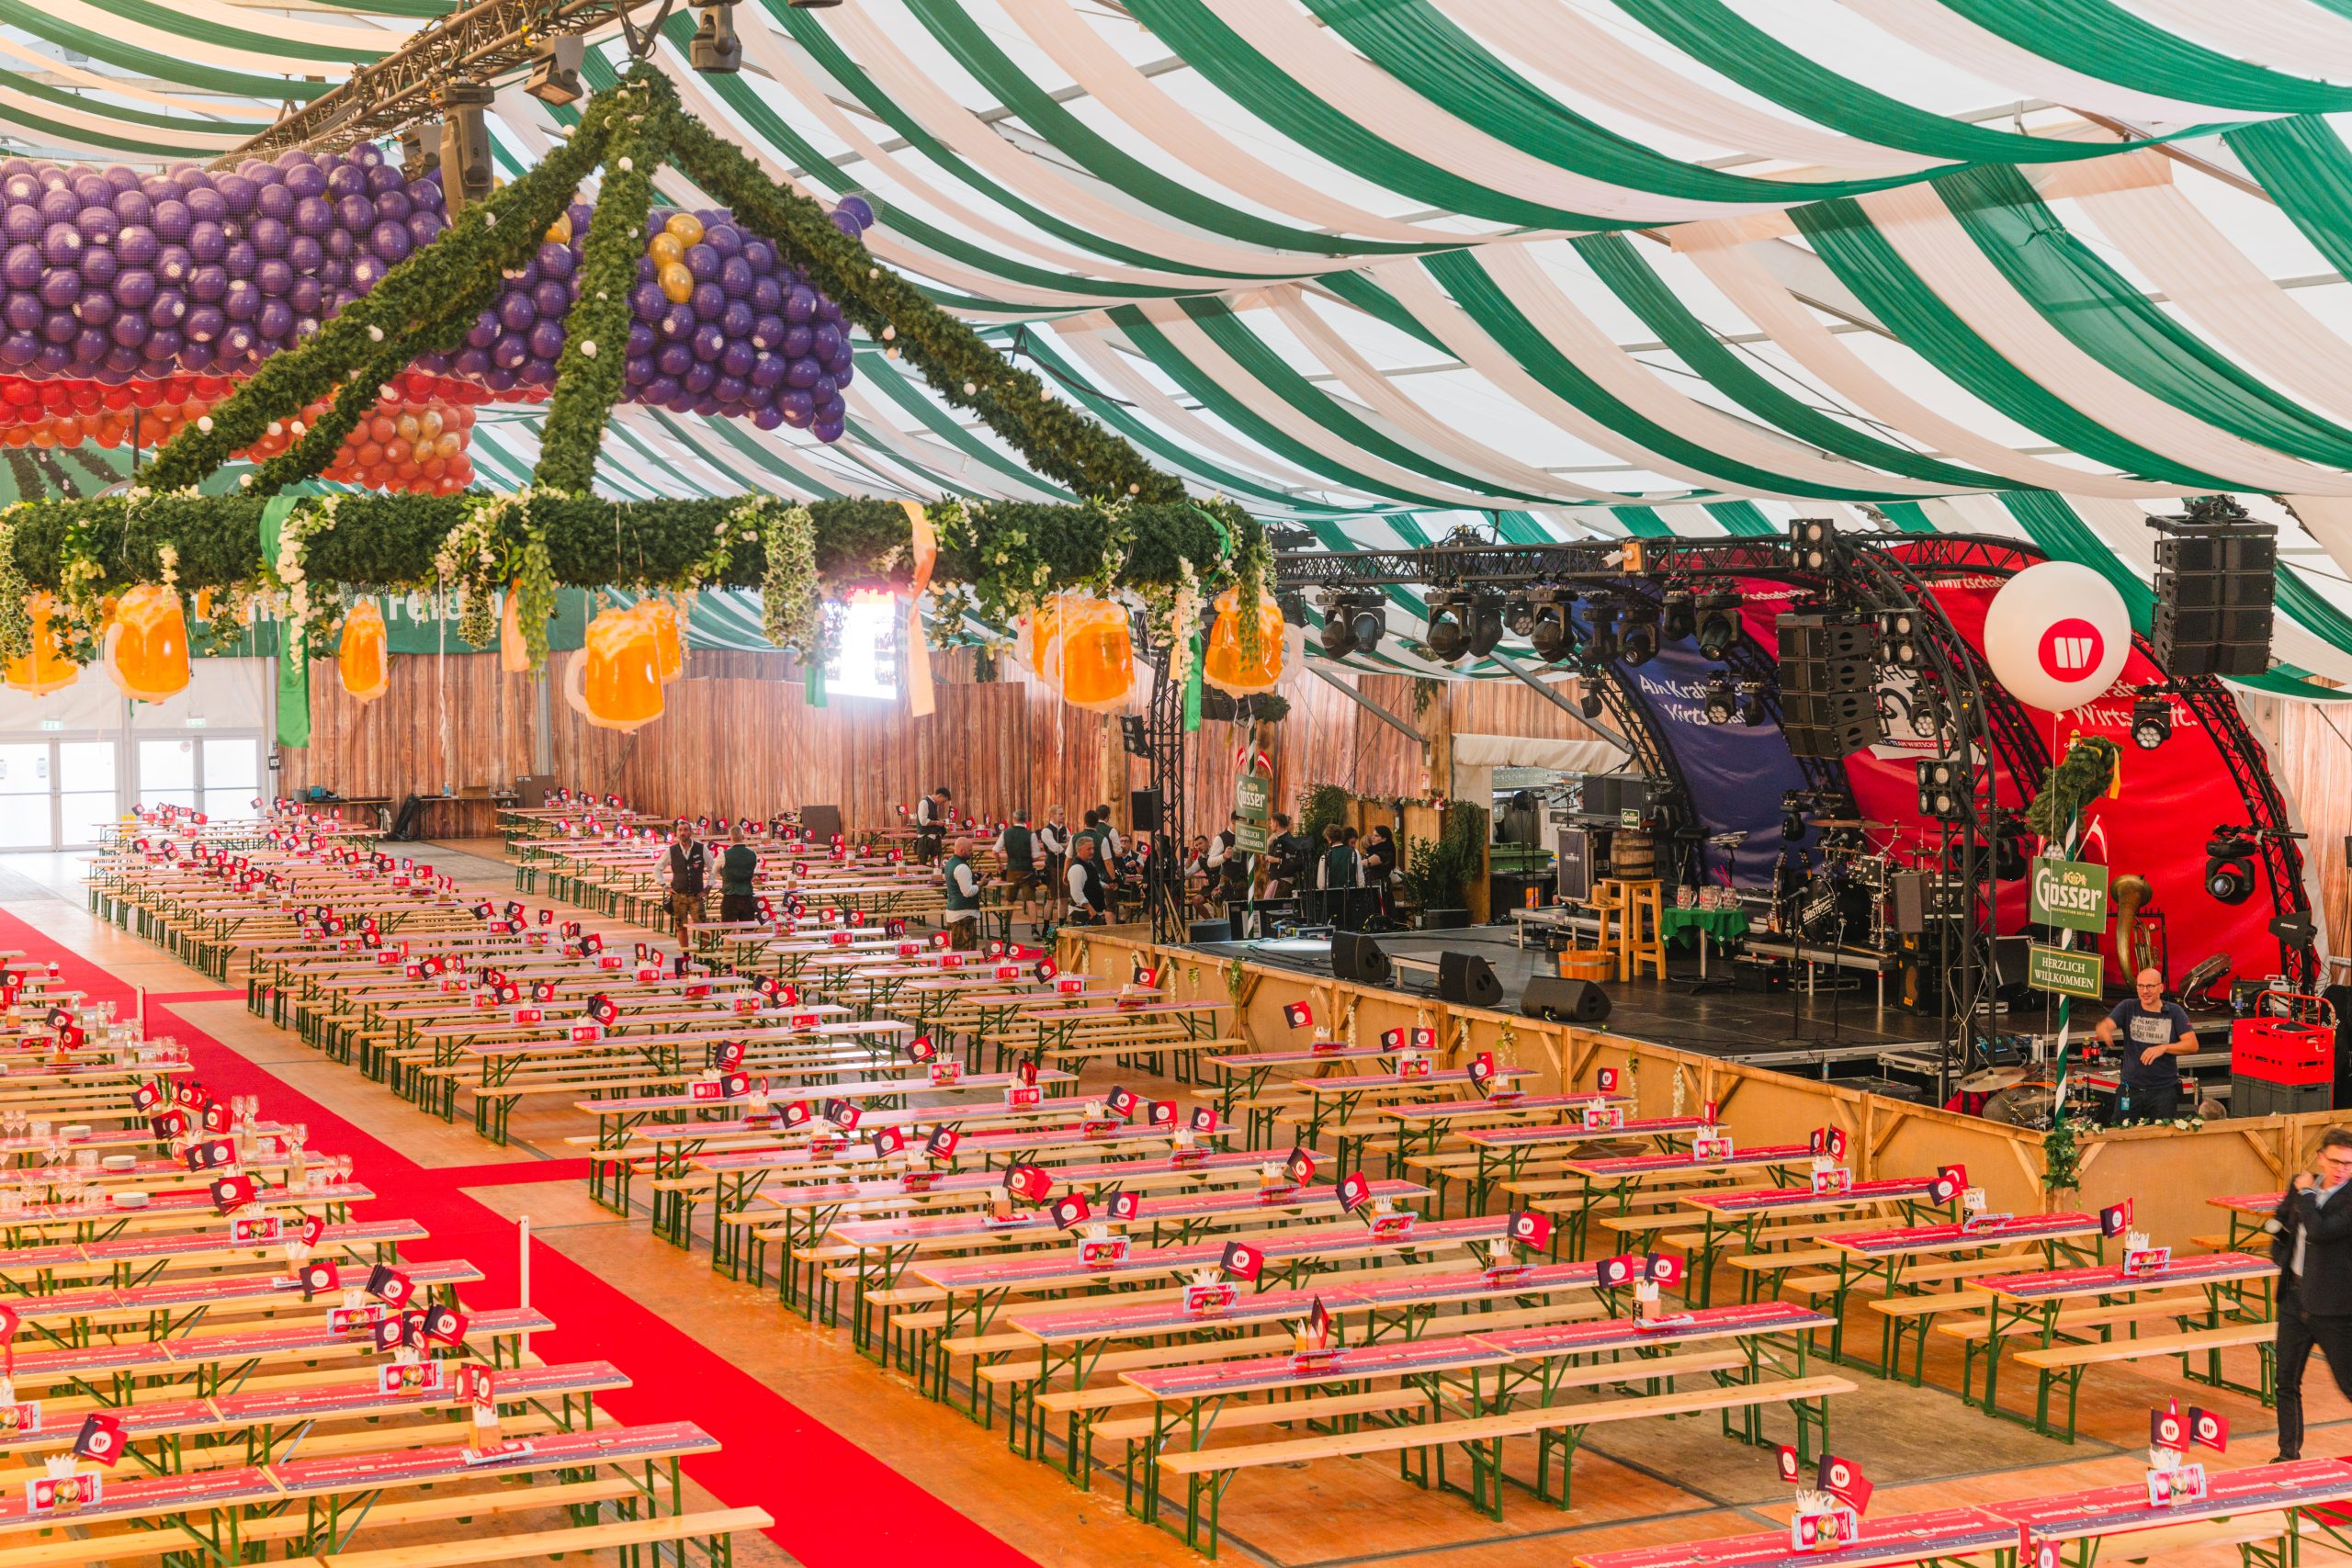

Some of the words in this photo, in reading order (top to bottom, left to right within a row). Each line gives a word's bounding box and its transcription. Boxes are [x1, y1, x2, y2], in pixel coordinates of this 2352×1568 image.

[1237, 781, 1266, 808] Gösser
[2035, 867, 2102, 912] Gösser
[2041, 957, 2086, 974] HERZLICH
[2034, 968, 2095, 989] WILLKOMMEN
